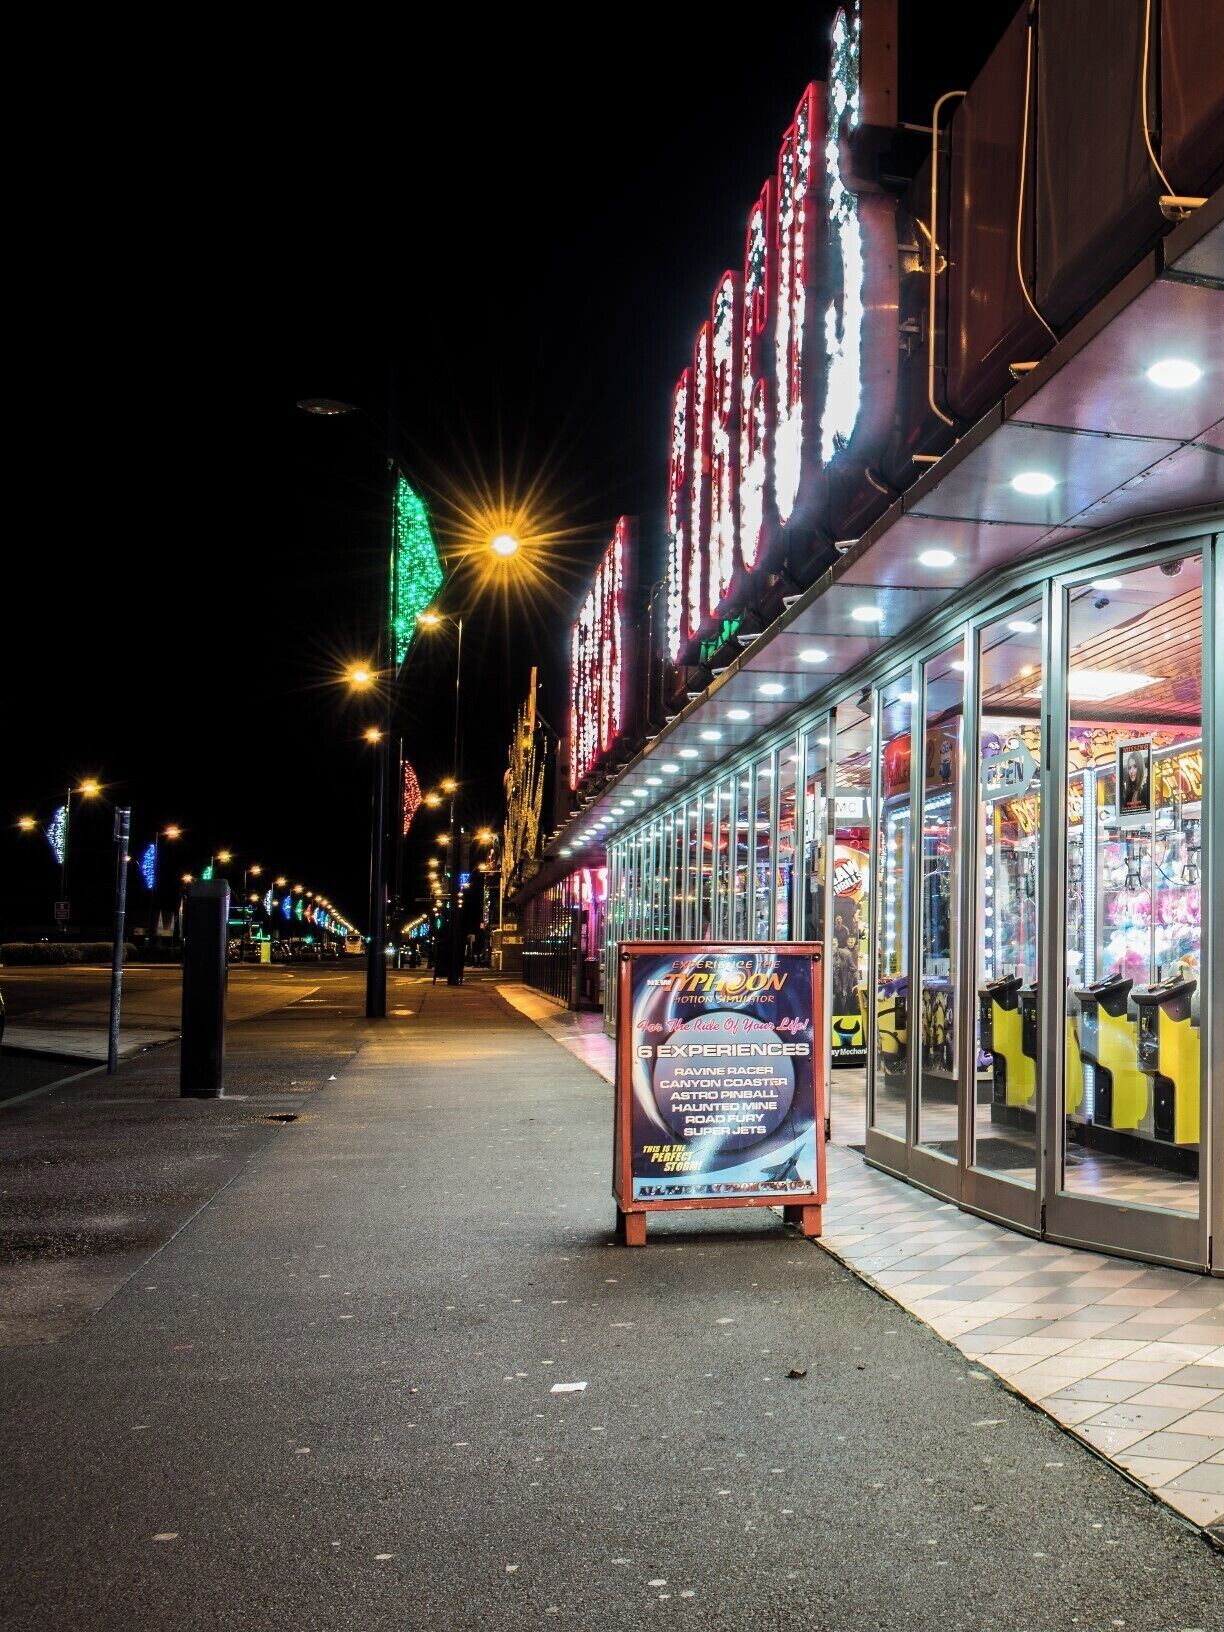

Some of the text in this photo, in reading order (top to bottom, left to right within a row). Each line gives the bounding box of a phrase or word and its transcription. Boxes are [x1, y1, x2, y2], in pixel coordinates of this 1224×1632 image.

[1123, 744, 1148, 753] MISSING
[672, 960, 781, 969] EXPERIENCE THE
[673, 995, 775, 1004] MOTION SIMULATOR
[637, 1016, 810, 1035] For The Ride Of Your Life!
[637, 1043, 810, 1058] 6 EXPERIENCES
[674, 1066, 774, 1076] RAVINE RACER
[660, 1078, 788, 1089] CANYON COASTER
[671, 1089, 778, 1100] ASTRO PINBALL
[671, 1101, 778, 1112] HAUNTED MINE
[685, 1114, 765, 1124] ROAD FURY
[683, 1125, 766, 1136] SUPER JETS
[662, 1145, 671, 1153] IS
[672, 1144, 687, 1152] THE
[651, 1151, 692, 1162] PERFECT
[639, 1185, 665, 1196] ALL
[723, 1182, 759, 1192] FROM
[788, 1179, 813, 1190] USA
